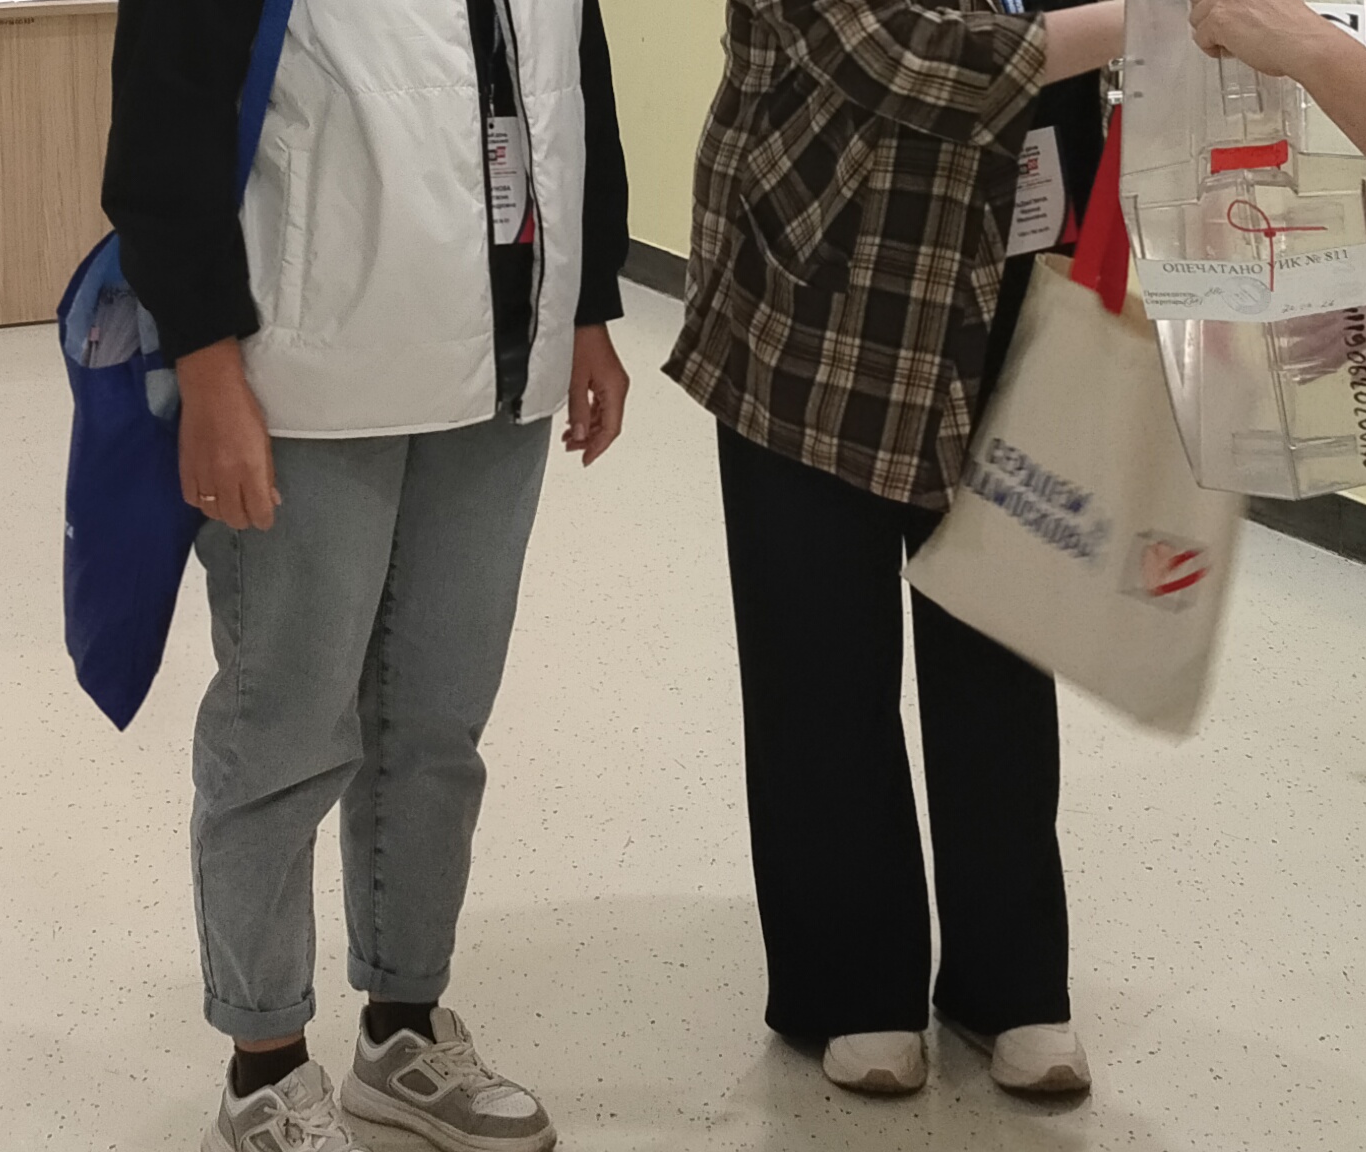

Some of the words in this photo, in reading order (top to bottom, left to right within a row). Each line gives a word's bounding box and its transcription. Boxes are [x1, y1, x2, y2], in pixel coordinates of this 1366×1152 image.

[1163, 262, 1263, 275] ОПЕЧАТАНО
[1267, 256, 1302, 270] УИК
[1324, 249, 1349, 262] 811
